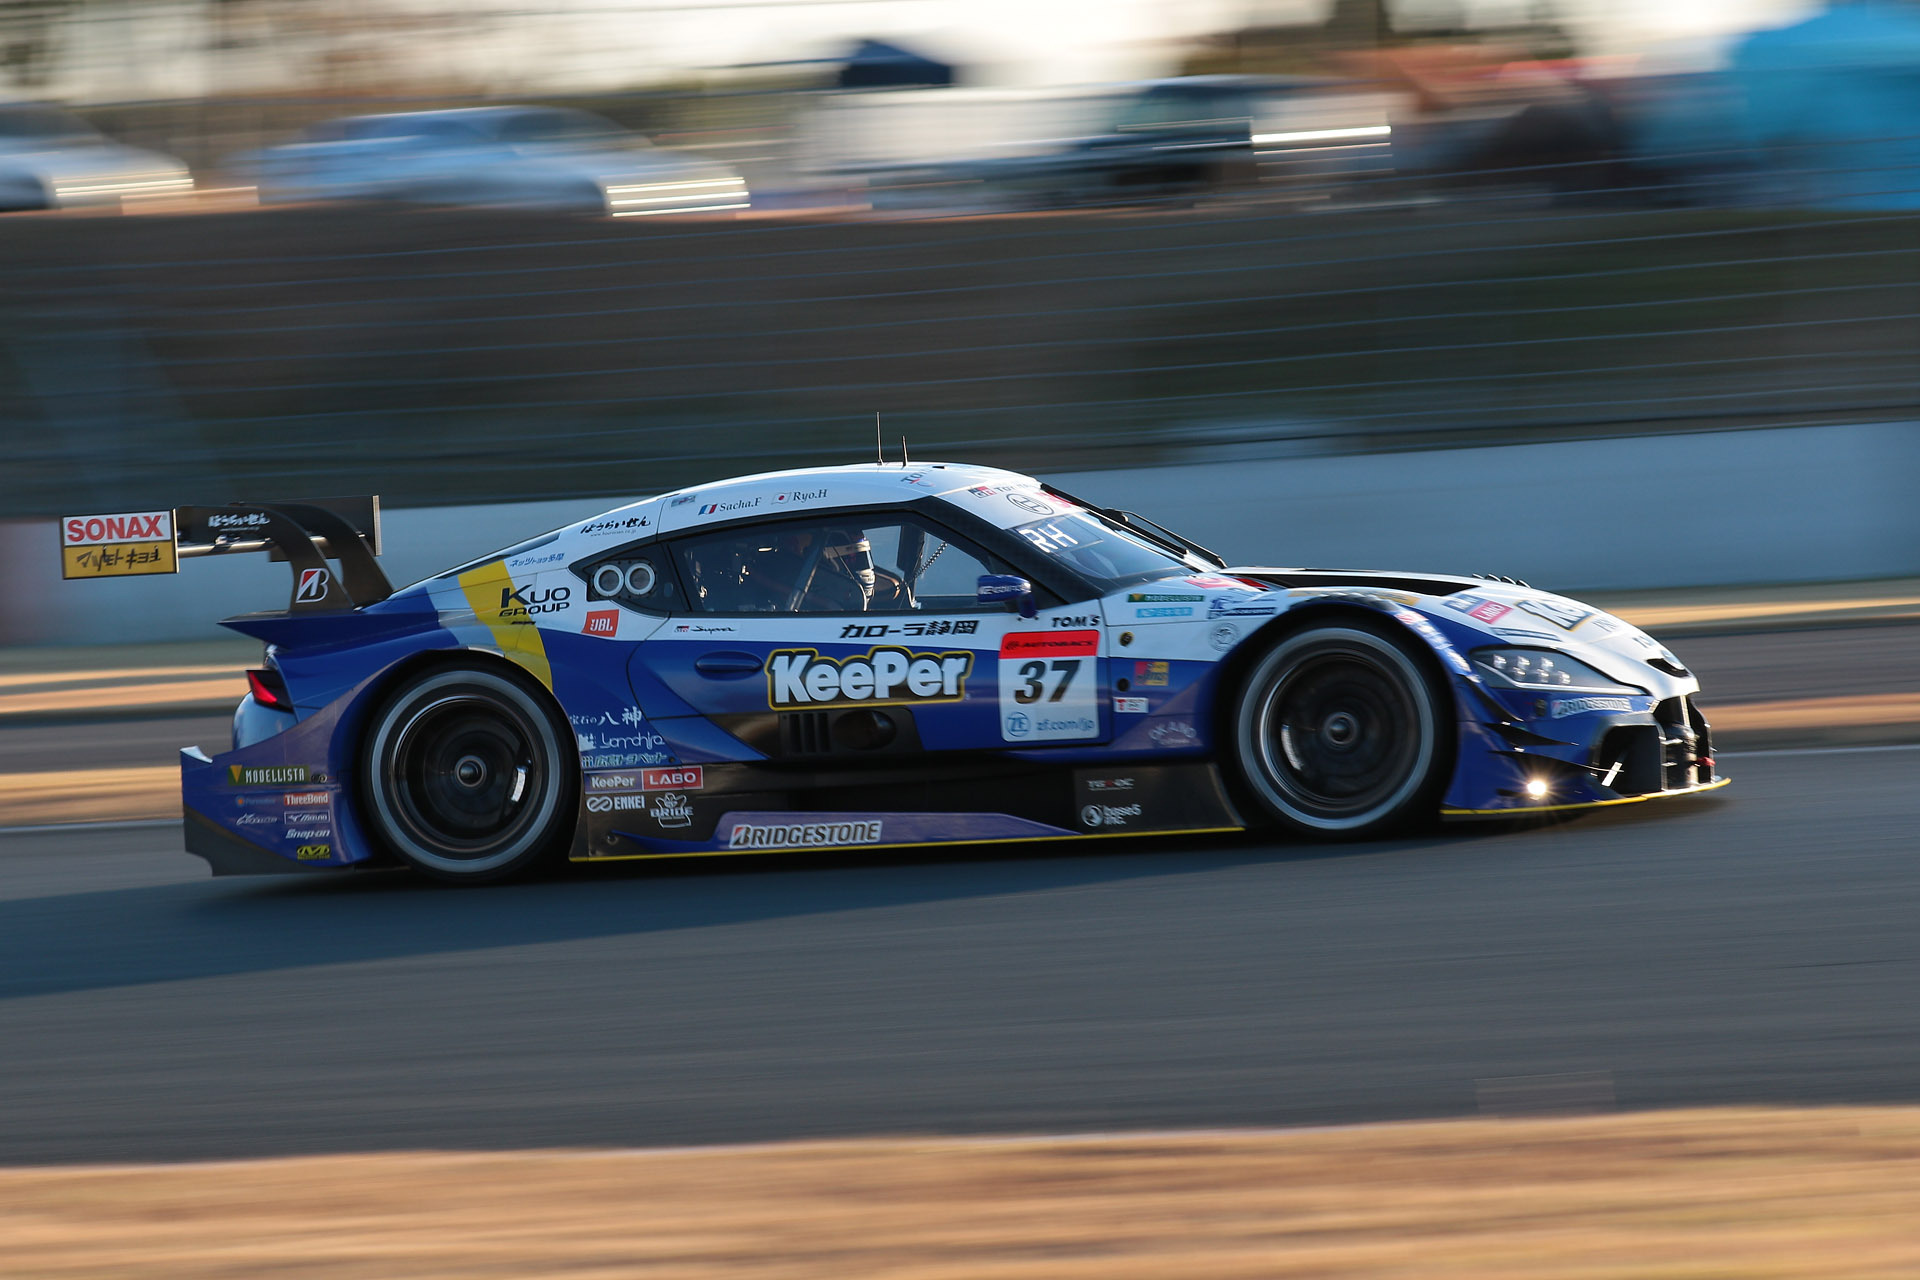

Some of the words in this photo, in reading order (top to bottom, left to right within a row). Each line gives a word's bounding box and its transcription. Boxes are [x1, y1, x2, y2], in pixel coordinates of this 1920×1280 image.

[792, 489, 827, 503] Ryo.H
[67, 515, 164, 542] SONAX
[1019, 523, 1079, 553] RH
[498, 602, 570, 617] GROUP
[840, 620, 979, 639] カローラ静岡
[1052, 616, 1100, 628] TOM'S
[771, 651, 967, 704] KeePer
[1014, 660, 1081, 705] 37
[245, 768, 305, 784] MODELLISTA
[591, 776, 635, 789] KeePer
[649, 771, 697, 786] LABO
[285, 793, 328, 806] ThreeBond
[614, 795, 646, 811] ENKEI
[650, 806, 694, 818] BRIDE
[731, 822, 881, 847] BRIDGESTONE
